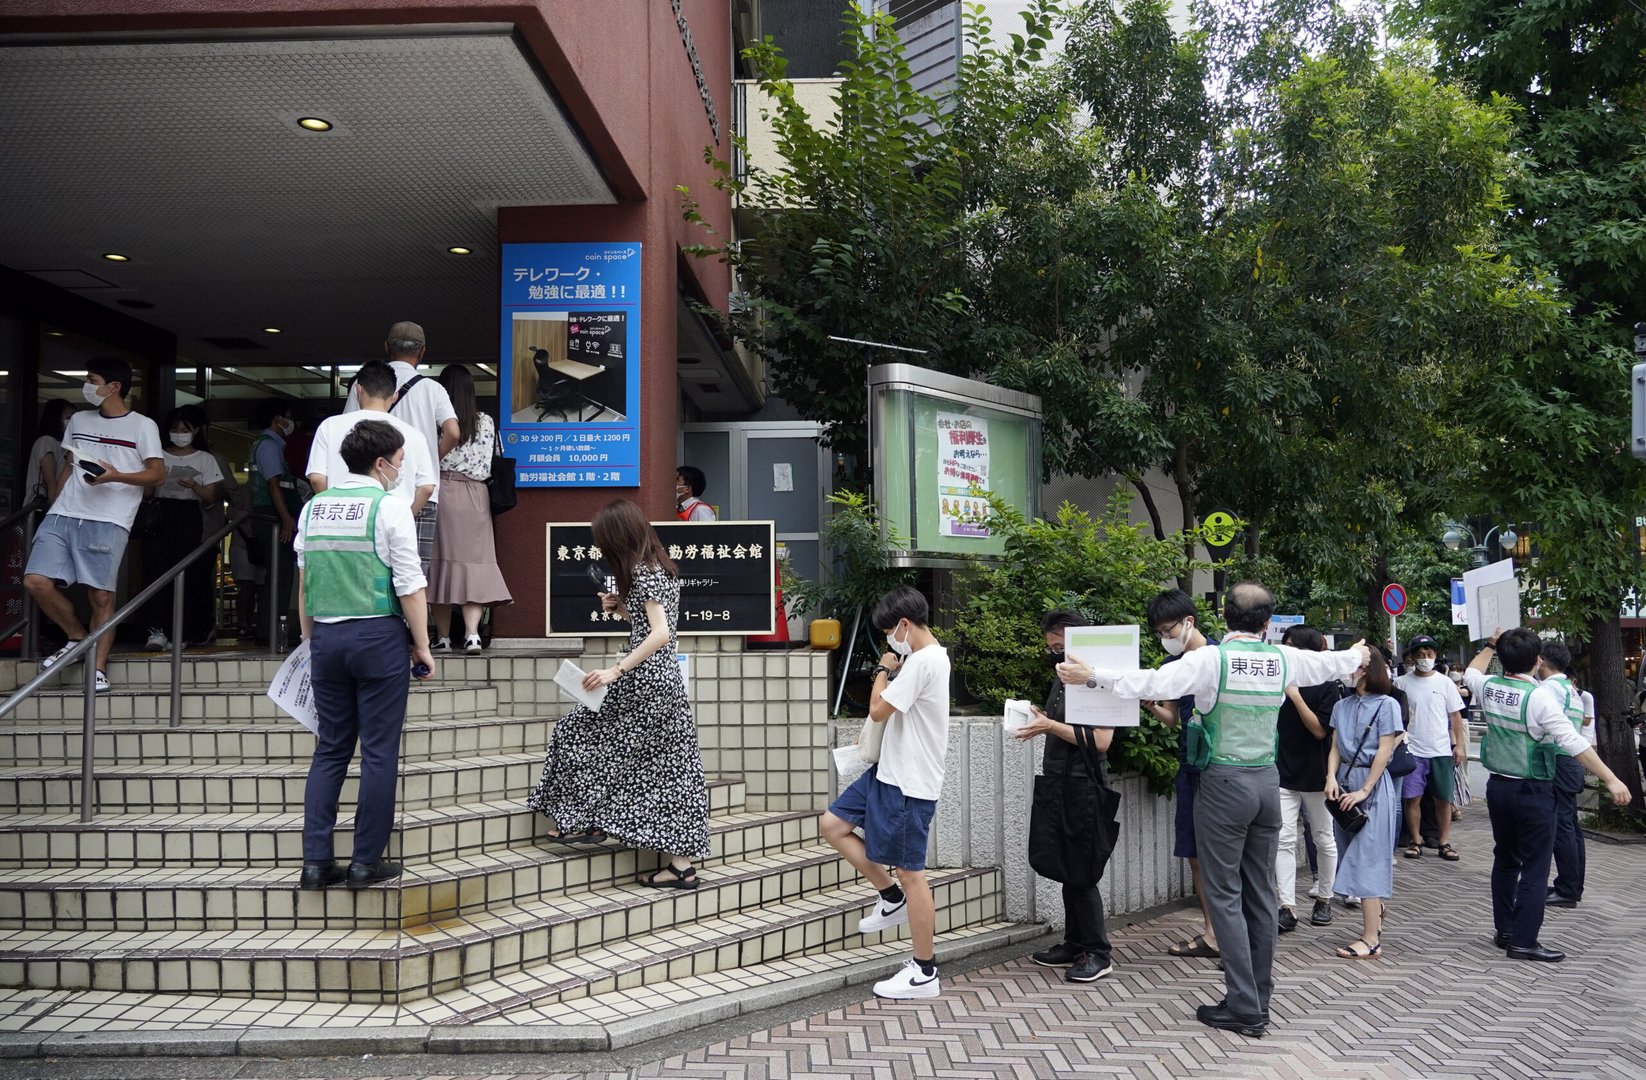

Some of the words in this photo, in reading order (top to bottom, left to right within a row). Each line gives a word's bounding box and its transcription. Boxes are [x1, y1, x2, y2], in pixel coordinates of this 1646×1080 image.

[603, 254, 628, 263] space
[311, 502, 365, 521] 東京都
[668, 543, 764, 560] 勤労福祉会館
[684, 610, 731, 621] 1-19-8
[1230, 657, 1281, 677] 東京都
[1484, 686, 1521, 708] 東京都
